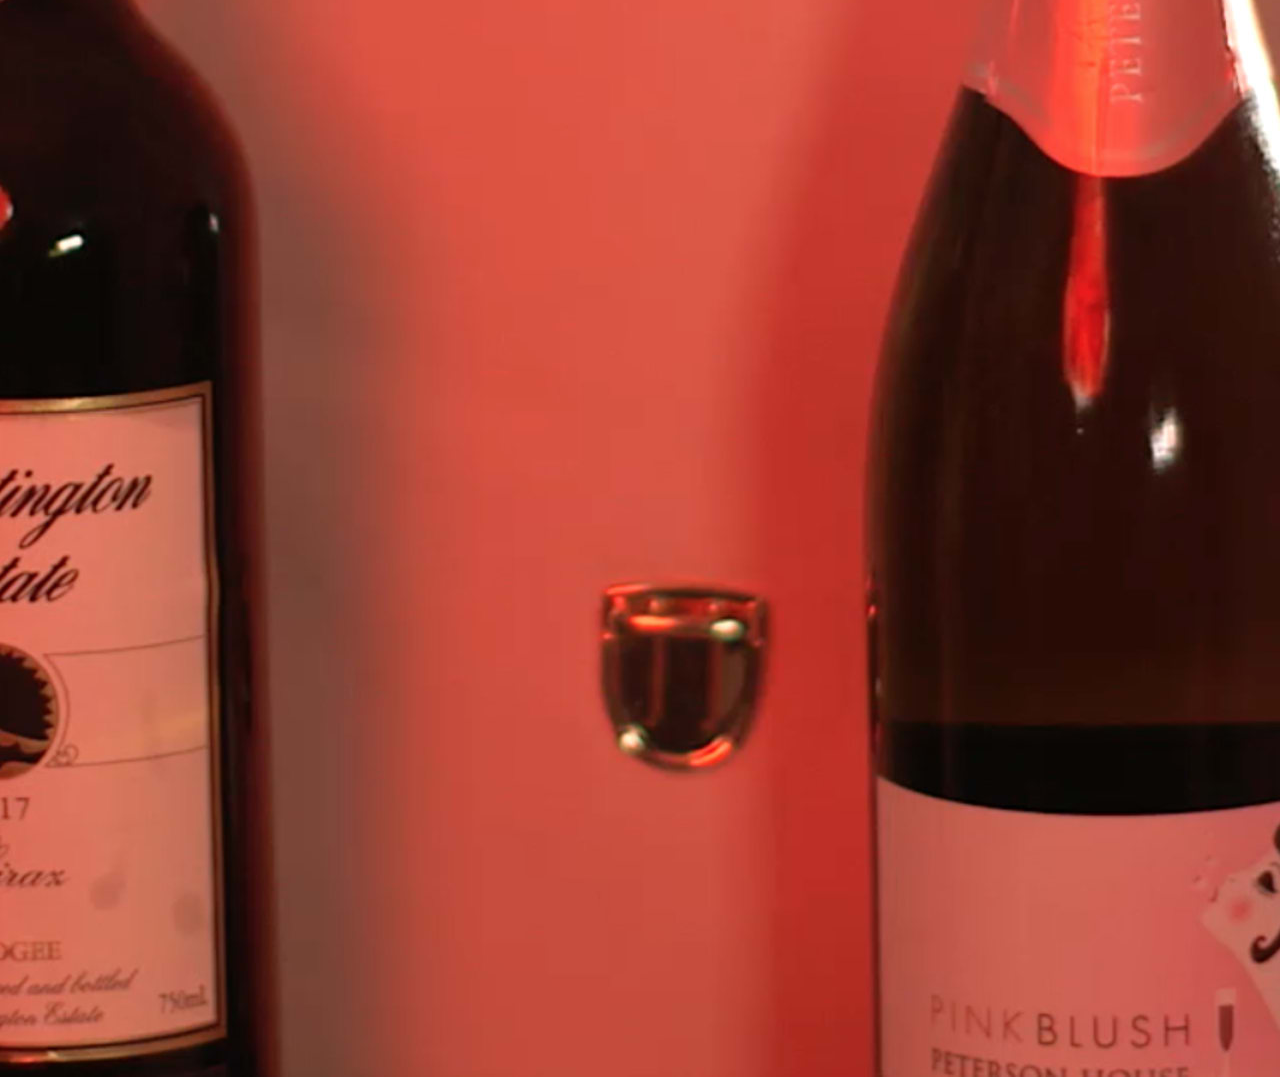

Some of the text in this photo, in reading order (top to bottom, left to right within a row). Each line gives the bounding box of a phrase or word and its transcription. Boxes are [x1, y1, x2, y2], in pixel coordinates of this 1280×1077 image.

[26, 974, 72, 995] and
[70, 968, 139, 994] bottled
[44, 1001, 104, 1023] Estate
